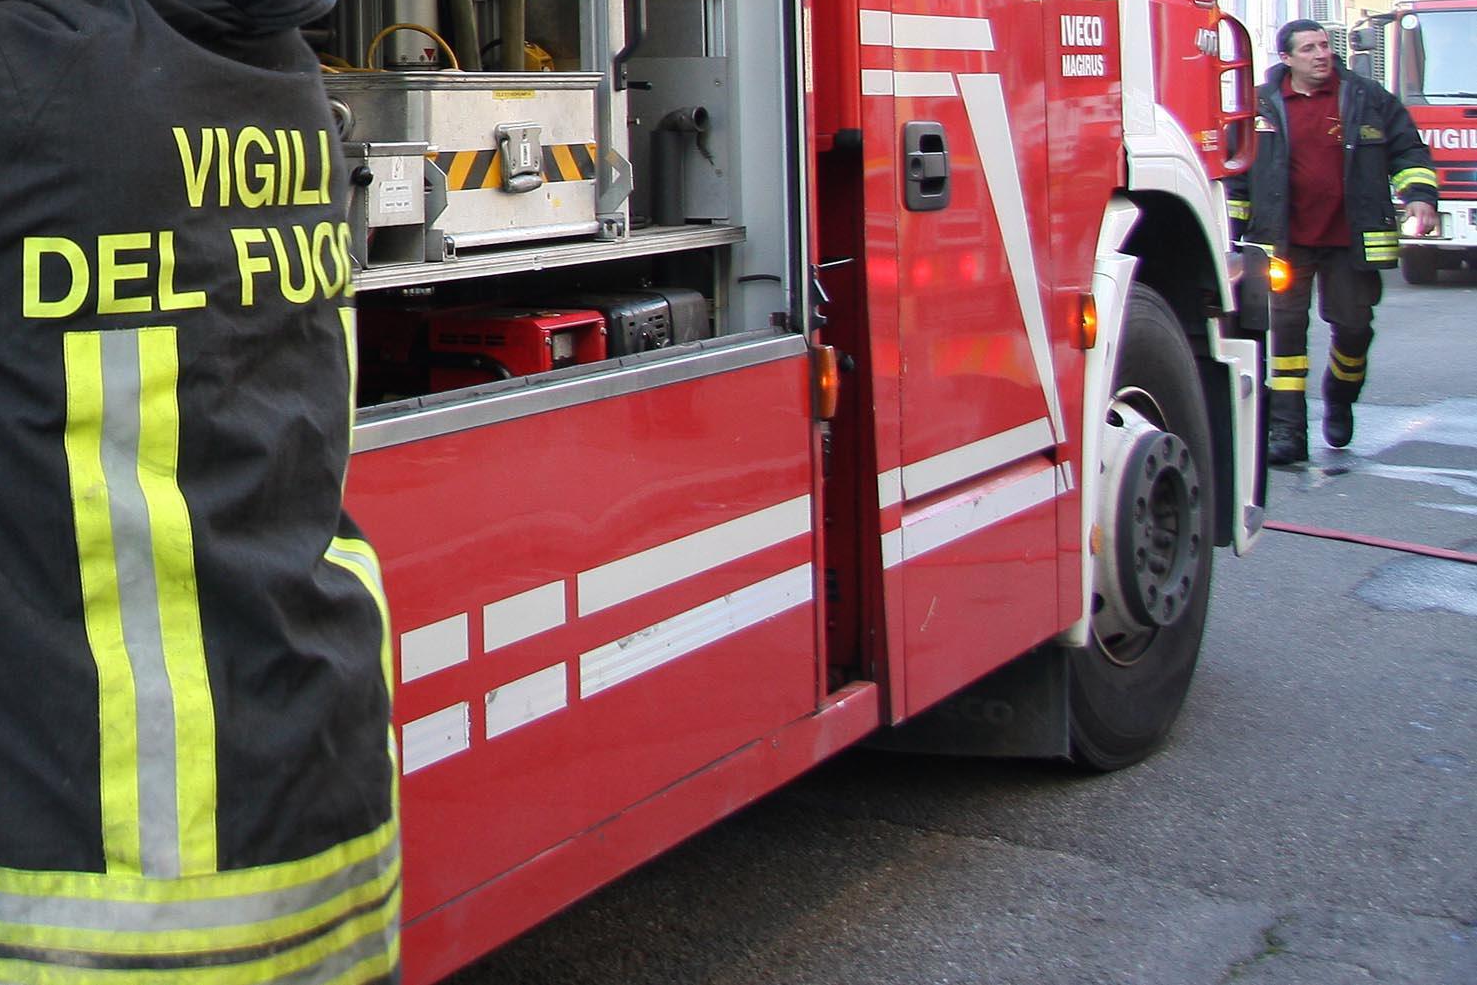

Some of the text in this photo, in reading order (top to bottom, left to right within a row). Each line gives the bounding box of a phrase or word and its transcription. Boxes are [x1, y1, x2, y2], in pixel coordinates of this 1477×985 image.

[1060, 15, 1103, 47] IVECO
[1061, 54, 1105, 78] MAGIRUS
[172, 126, 331, 209] VIGILI
[23, 230, 207, 318] DEL
